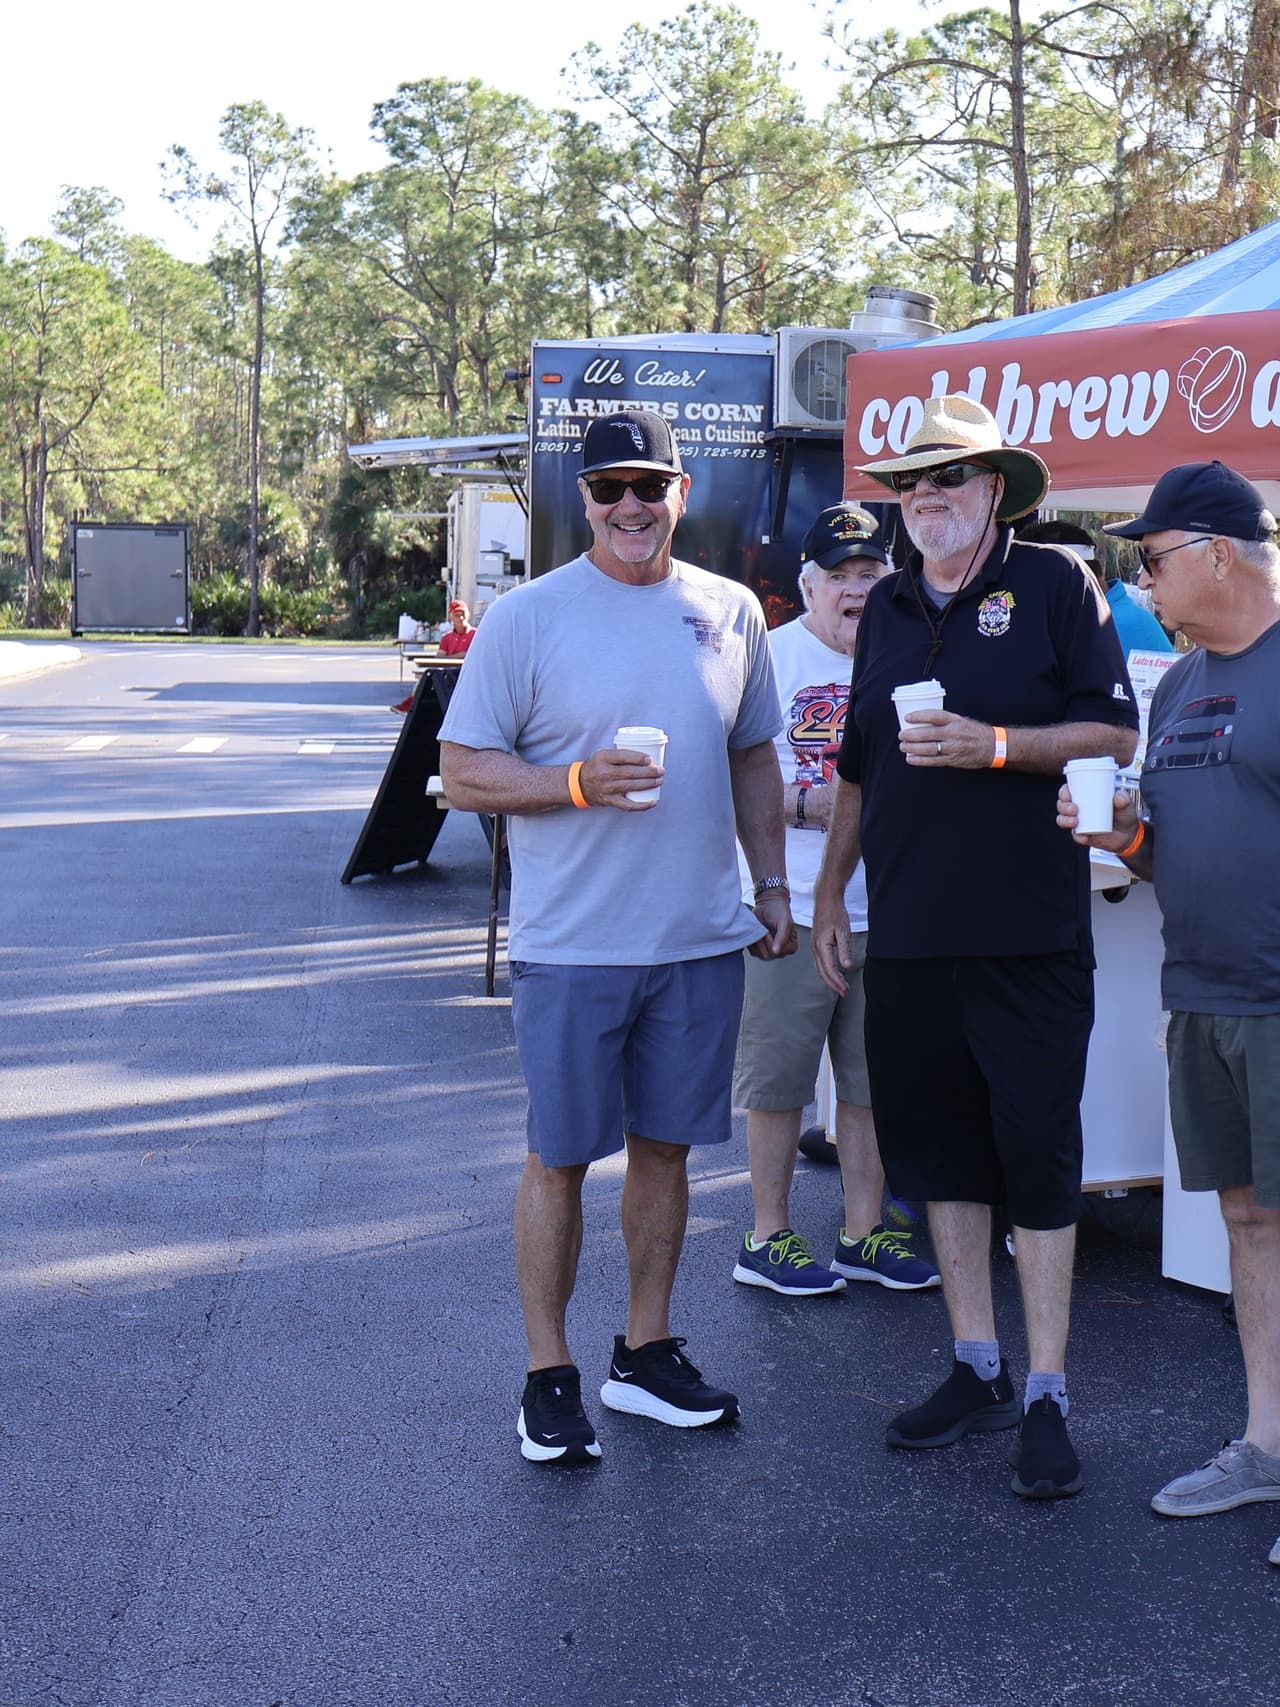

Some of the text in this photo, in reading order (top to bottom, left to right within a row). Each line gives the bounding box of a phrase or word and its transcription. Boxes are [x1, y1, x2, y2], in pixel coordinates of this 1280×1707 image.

[583, 359, 706, 387] We Cater!
[684, 402, 764, 422] CORN
[995, 362, 1170, 446] brew
[536, 418, 582, 437] Latin
[705, 424, 766, 444] Cuisine
[534, 441, 570, 453] (305)
